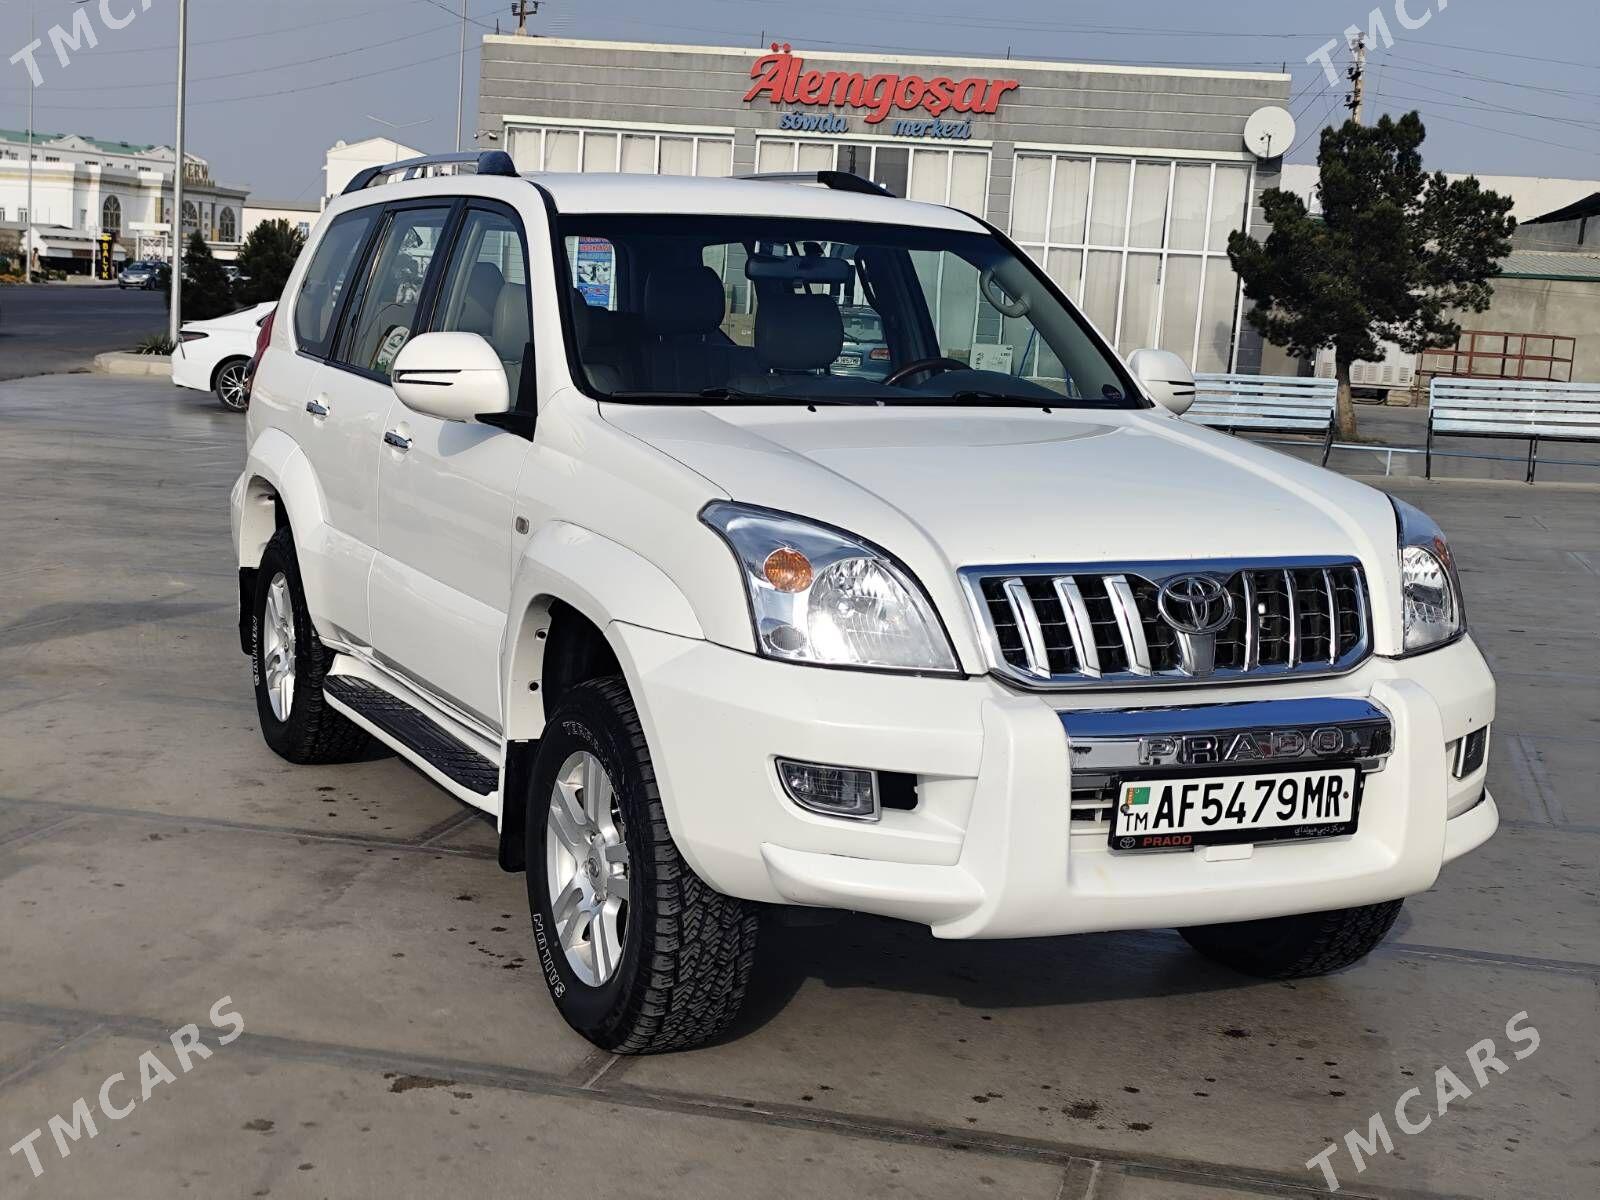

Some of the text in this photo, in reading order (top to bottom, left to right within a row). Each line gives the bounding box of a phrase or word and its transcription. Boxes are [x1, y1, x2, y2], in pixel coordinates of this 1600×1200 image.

[743, 43, 1020, 124] Älemgoşar
[892, 117, 972, 139] merkezi
[1137, 727, 1344, 766] PRADO
[1152, 775, 1343, 829] AF5479MR
[1124, 811, 1148, 832] TM
[1143, 835, 1192, 847] PRADO
